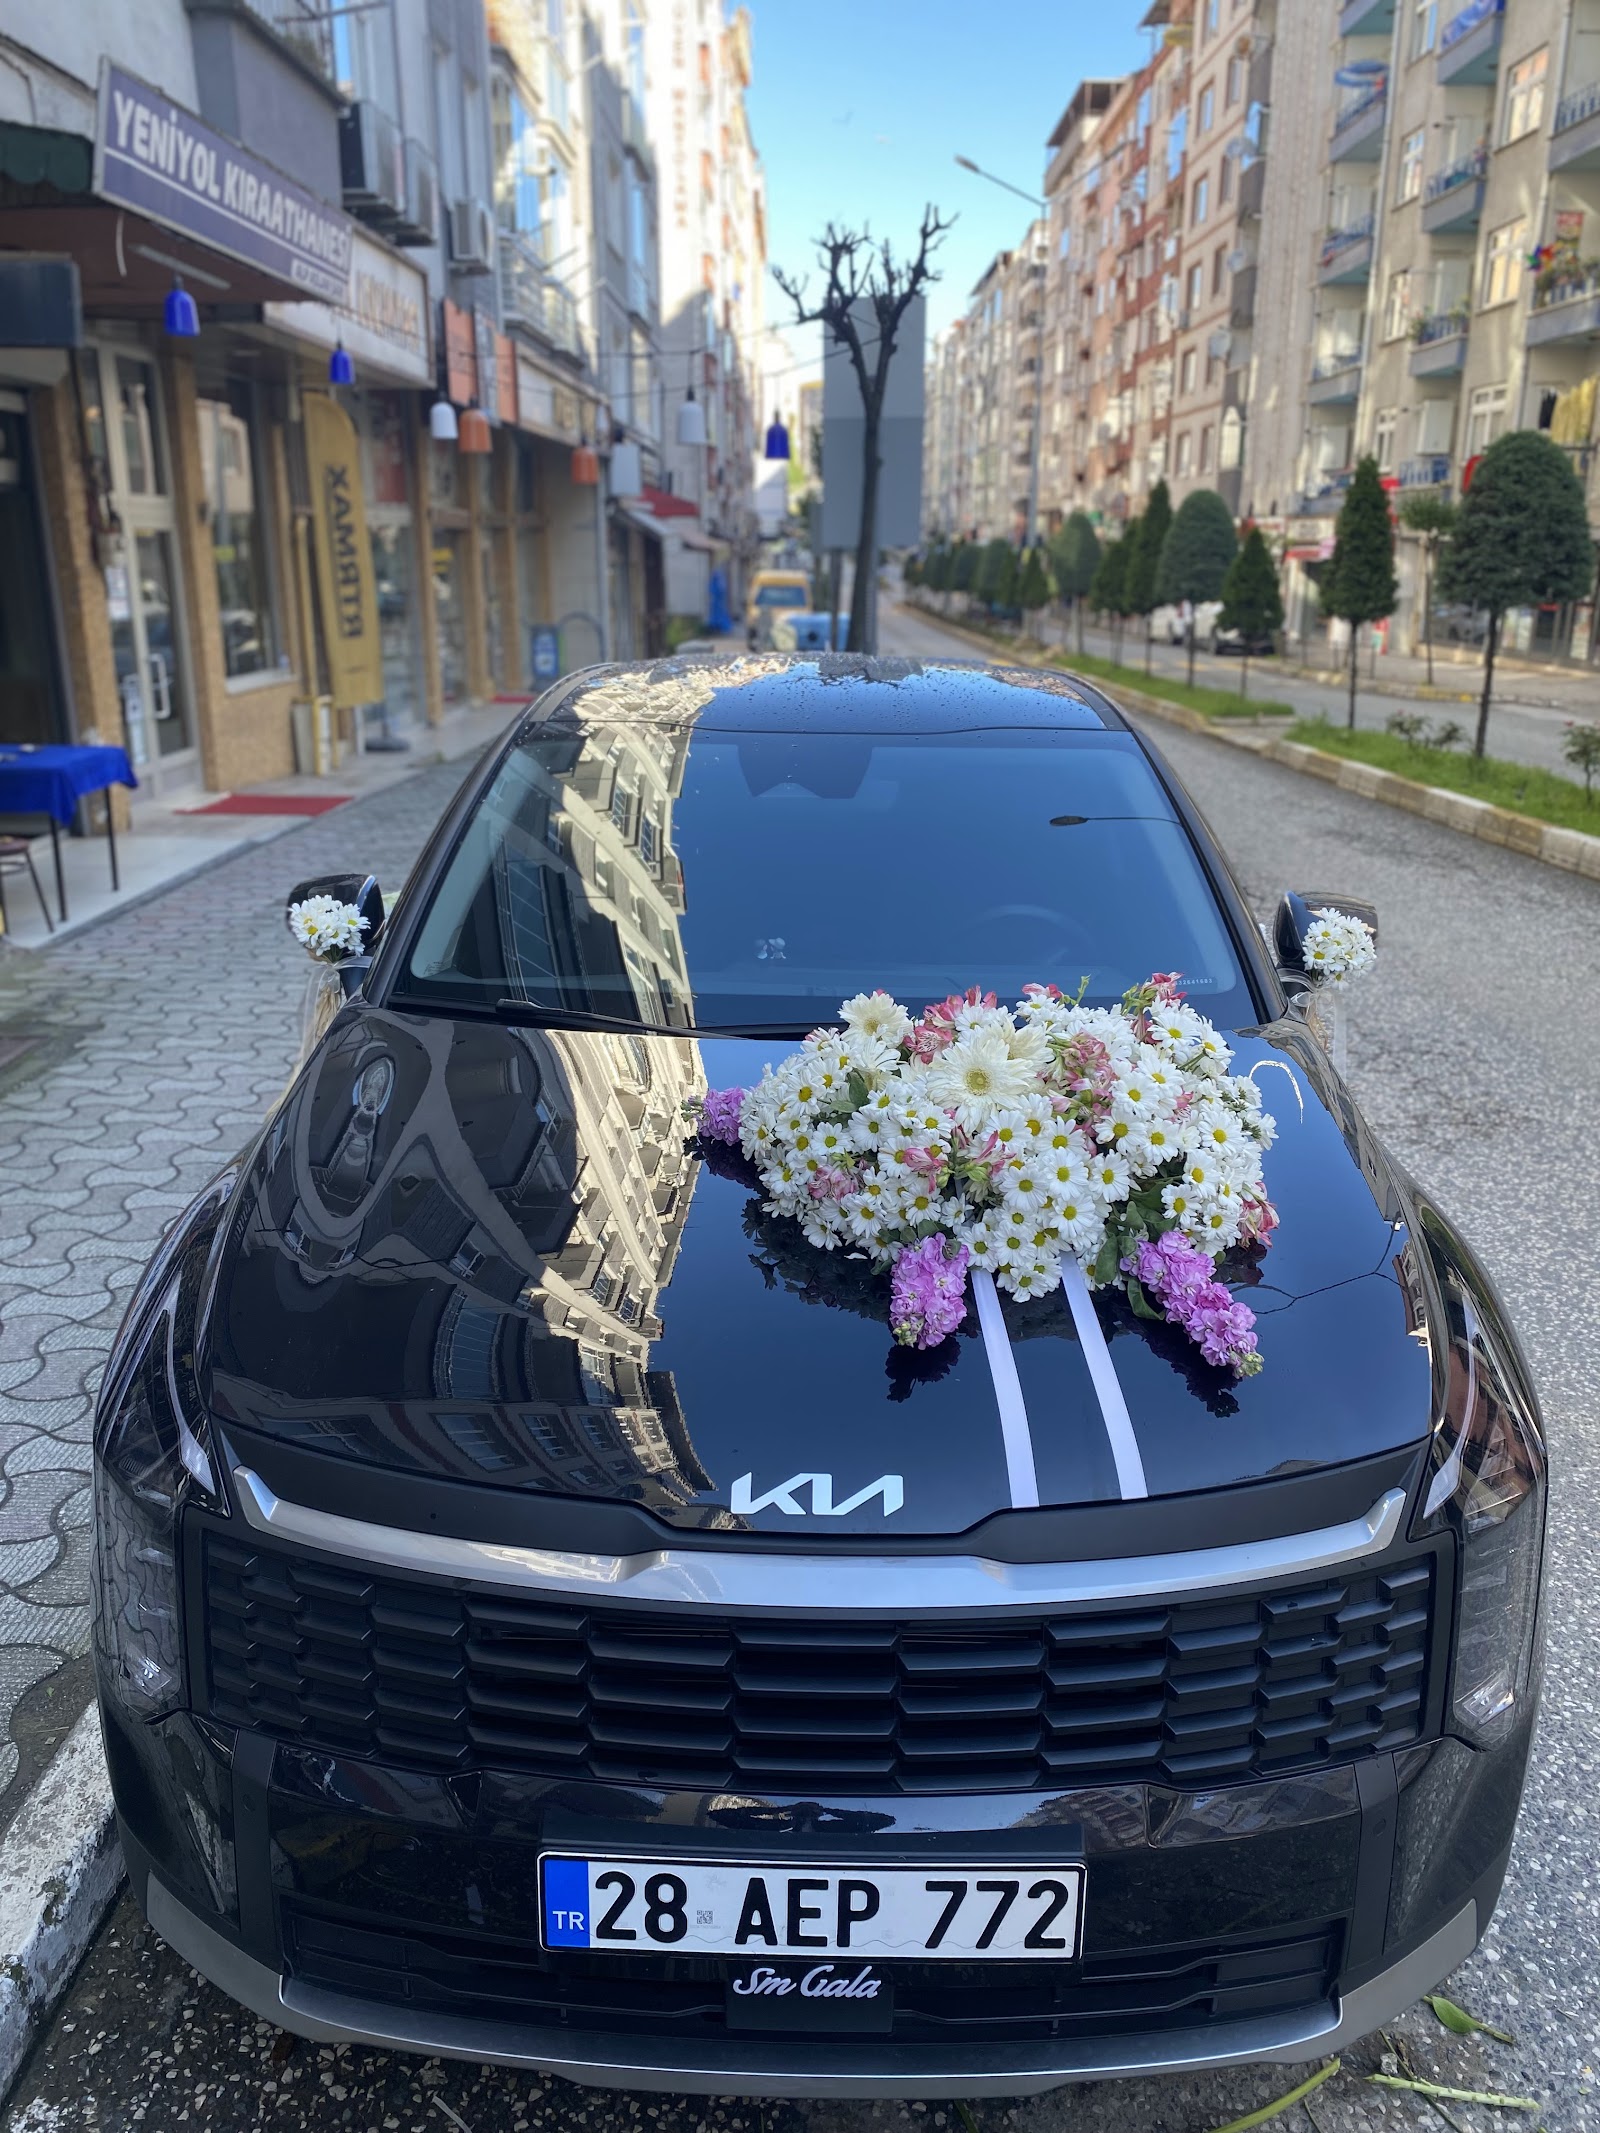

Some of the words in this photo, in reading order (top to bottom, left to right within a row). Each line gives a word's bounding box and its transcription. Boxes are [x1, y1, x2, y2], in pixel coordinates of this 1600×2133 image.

[114, 89, 220, 200] YENİYOL
[223, 160, 352, 272] KIRAATHANESİ
[731, 1471, 904, 1518] KIA
[552, 1910, 585, 1931] TR
[595, 1871, 688, 1943] 28
[734, 1877, 880, 1948] AEP
[924, 1879, 1069, 1949] 772
[732, 1967, 797, 1996] Sm
[799, 1964, 882, 1999] Gala
